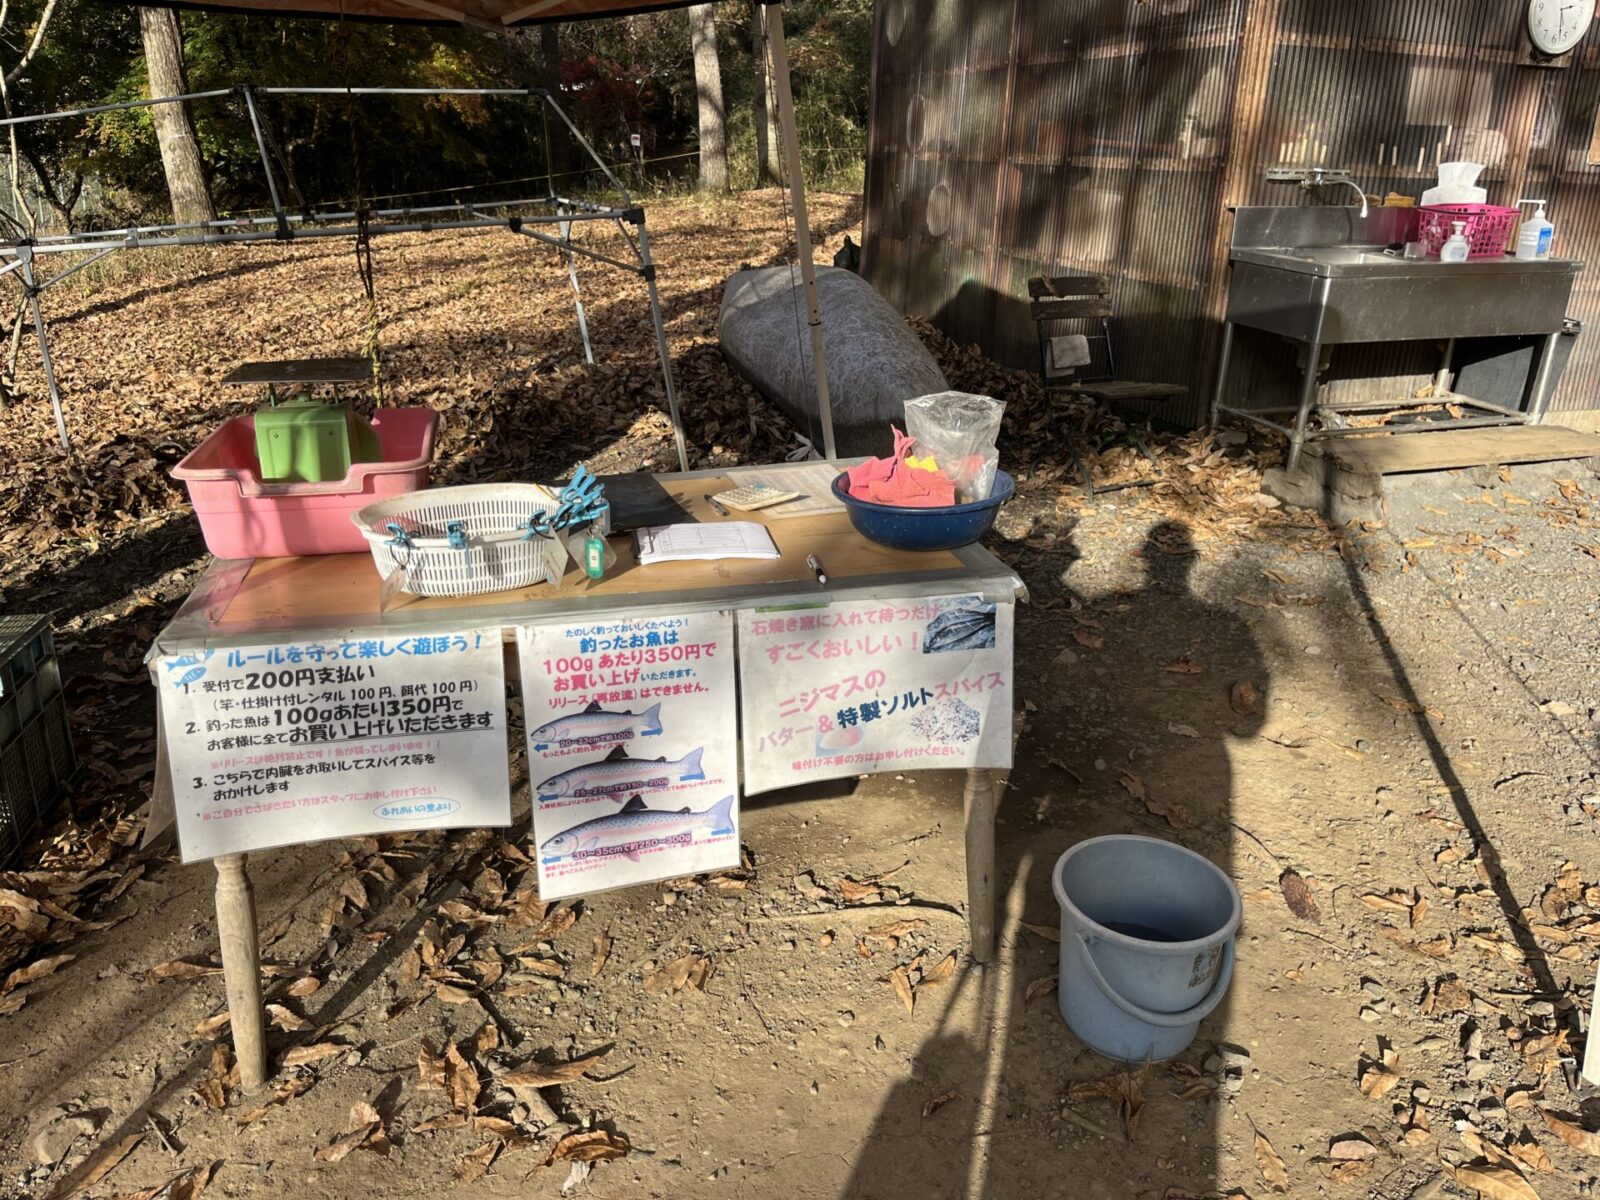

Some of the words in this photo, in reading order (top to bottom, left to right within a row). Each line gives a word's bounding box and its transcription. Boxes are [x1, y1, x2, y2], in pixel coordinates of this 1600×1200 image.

[228, 635, 481, 668] ルールを守って楽しく遊ぼう！
[580, 630, 679, 653] 釣ったお魚は
[766, 632, 919, 664] すごくおいしい！
[543, 658, 593, 675] 100g
[599, 643, 717, 668] あたり350円で
[203, 665, 375, 693] 受付で200円支払い
[351, 688, 375, 701] 100
[432, 682, 456, 694] 100
[554, 668, 696, 692] お買い上げいただきます。
[779, 669, 886, 719] ニジマスの
[186, 722, 200, 734] 2.
[207, 711, 493, 750] お客様に全てお買い上げいただきます
[193, 777, 207, 789] 3.
[213, 753, 435, 785] こちらで内臓をお取りしてスパイス等を
[213, 781, 290, 801] おかけします
